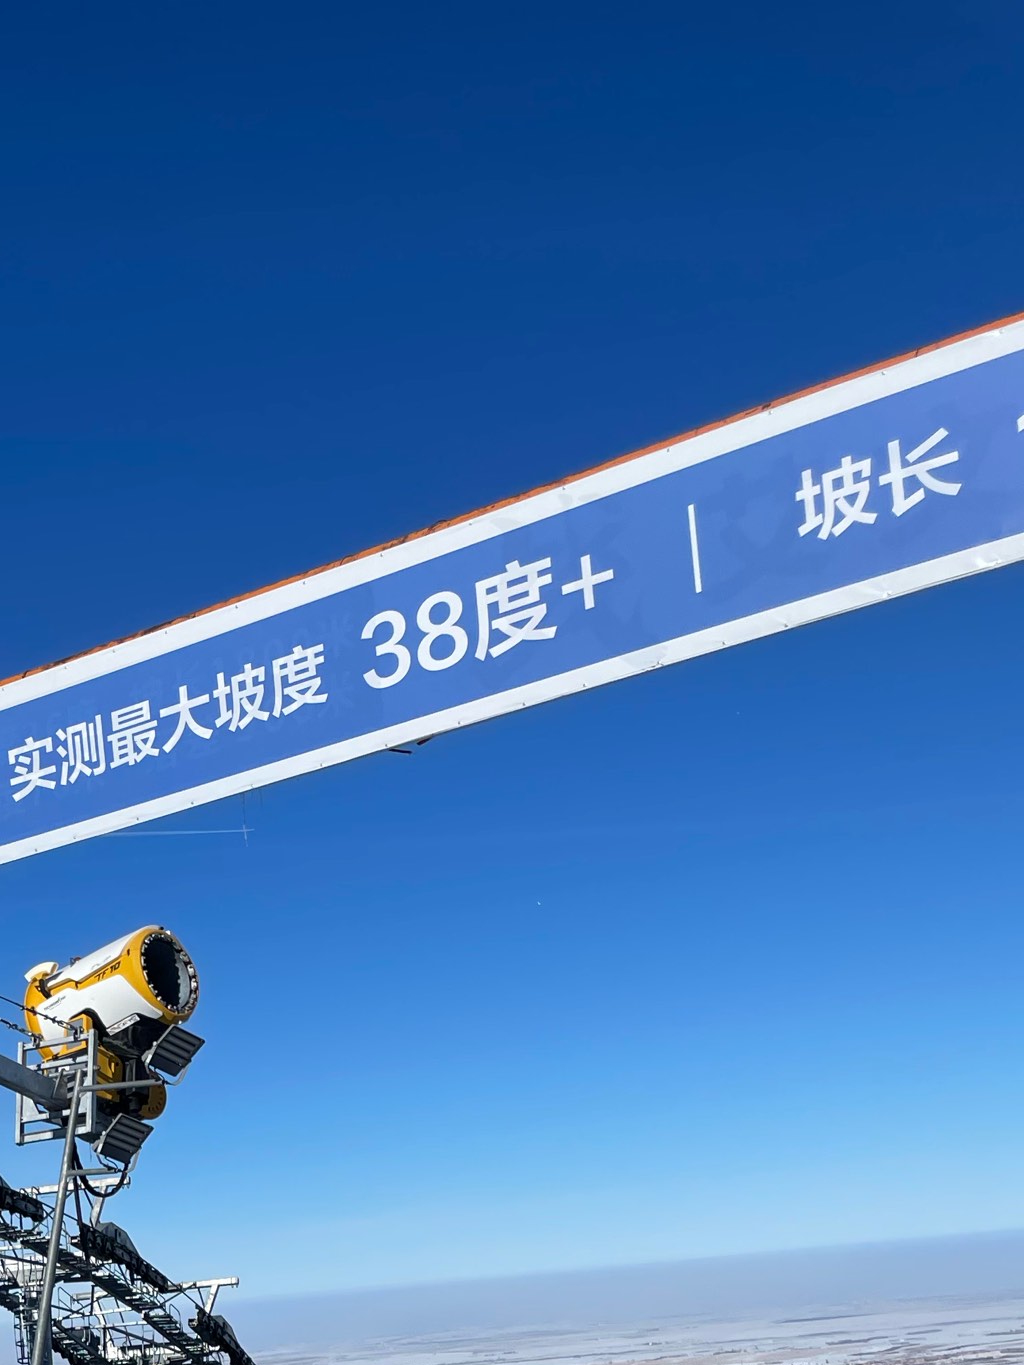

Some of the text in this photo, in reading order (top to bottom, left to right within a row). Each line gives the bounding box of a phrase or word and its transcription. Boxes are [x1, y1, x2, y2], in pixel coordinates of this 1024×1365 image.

[7, 644, 329, 801] 实测最大坡度
[360, 553, 615, 690] 38度+
[795, 427, 962, 541] 坡长
